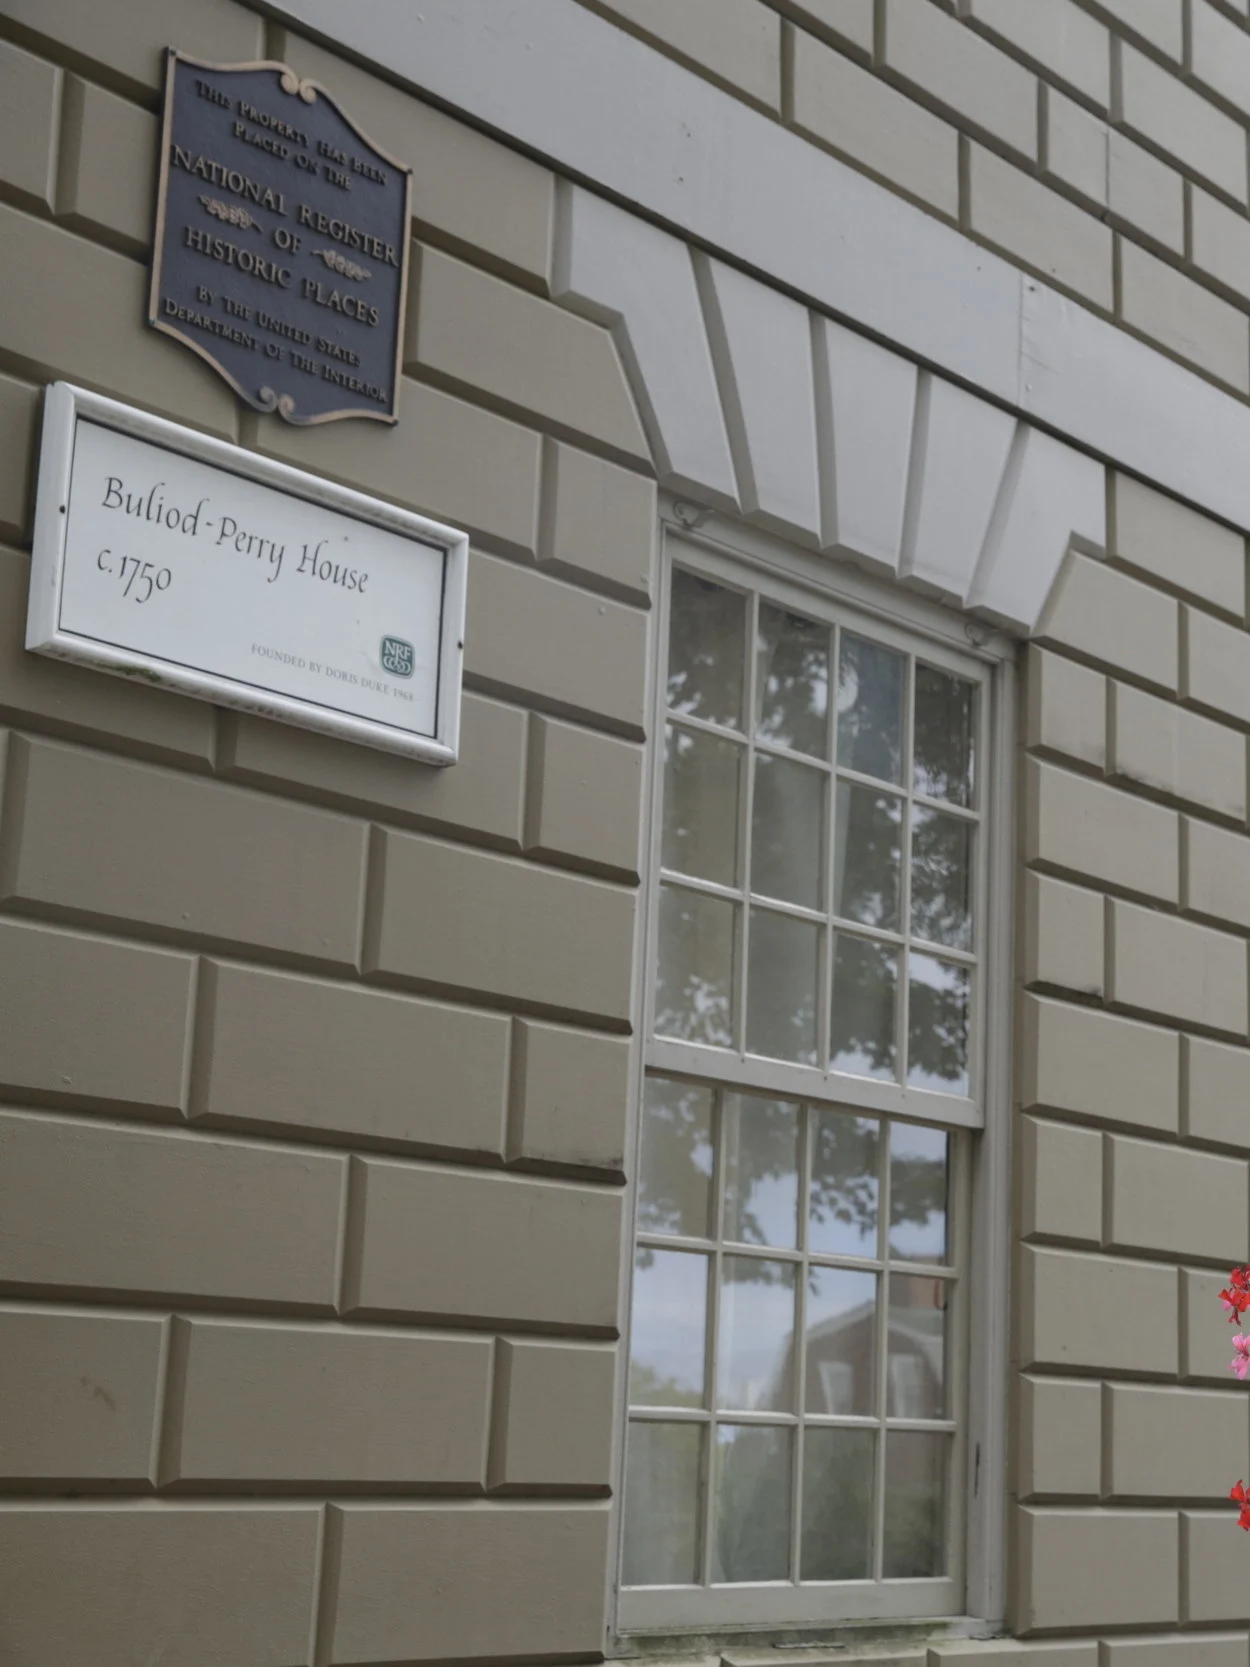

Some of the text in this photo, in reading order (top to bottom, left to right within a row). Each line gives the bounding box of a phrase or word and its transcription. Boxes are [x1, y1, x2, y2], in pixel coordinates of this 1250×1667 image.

[196, 79, 387, 186] THIS PROPERTY HAS BEEN
[234, 120, 352, 191] PLACED ON THE
[173, 144, 399, 267] NATIONAL REGISTER
[274, 228, 301, 253] OF
[185, 226, 381, 328] HISTORIC PLACES
[165, 298, 388, 403] DEPARTMENT OF THE INTERIOR
[198, 286, 361, 367] BY THE UNITED STATES
[297, 540, 369, 593] House
[251, 643, 306, 669] FOUNDED
[309, 661, 323, 674] BY
[325, 666, 358, 685] DORIS
[360, 677, 389, 695] DUKE
[384, 639, 411, 661] NRF
